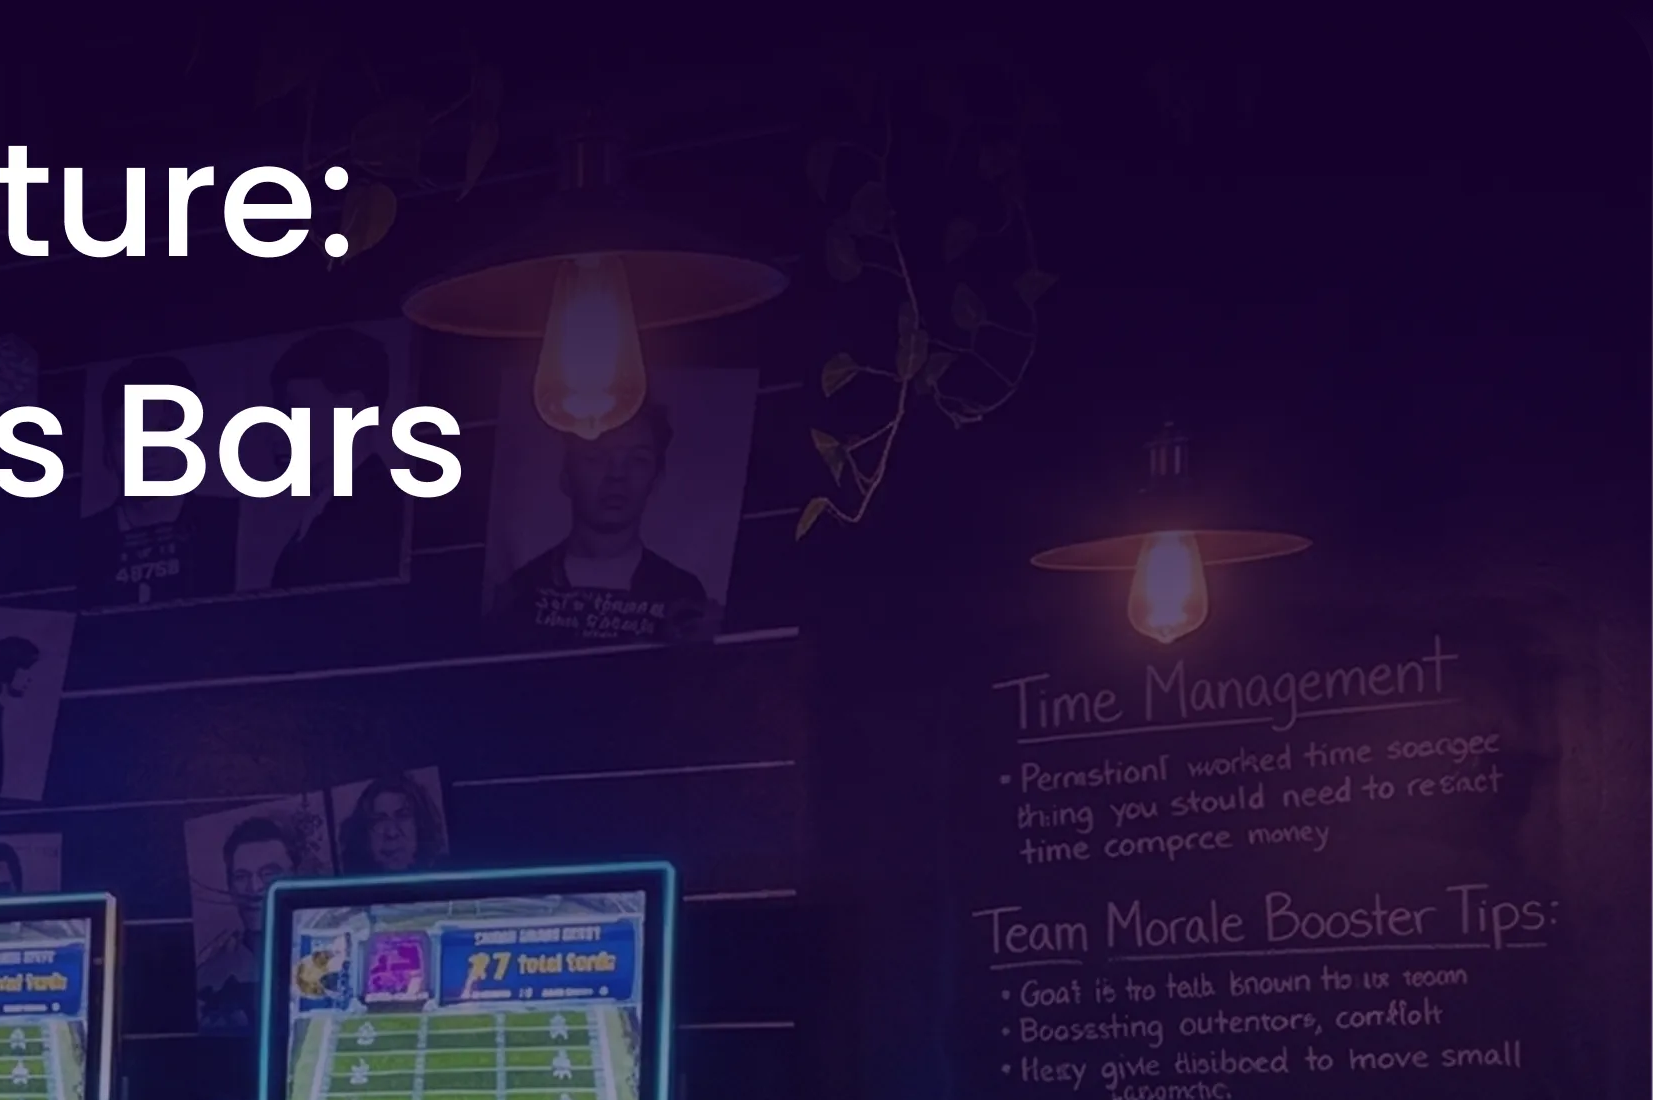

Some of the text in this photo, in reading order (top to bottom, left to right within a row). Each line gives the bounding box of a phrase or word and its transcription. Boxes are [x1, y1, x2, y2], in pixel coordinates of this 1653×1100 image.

[993, 634, 1459, 733] Time Management
[1304, 741, 1373, 767] time
[1110, 801, 1158, 828] you
[1283, 775, 1352, 808] need
[1361, 774, 1395, 800] to
[1019, 838, 1091, 865] time
[1248, 824, 1330, 852] money
[972, 882, 1560, 956] Team Morale Booster Tips:
[1305, 1045, 1334, 1072] to
[1349, 1048, 1429, 1071] move
[1442, 1040, 1520, 1068] small
